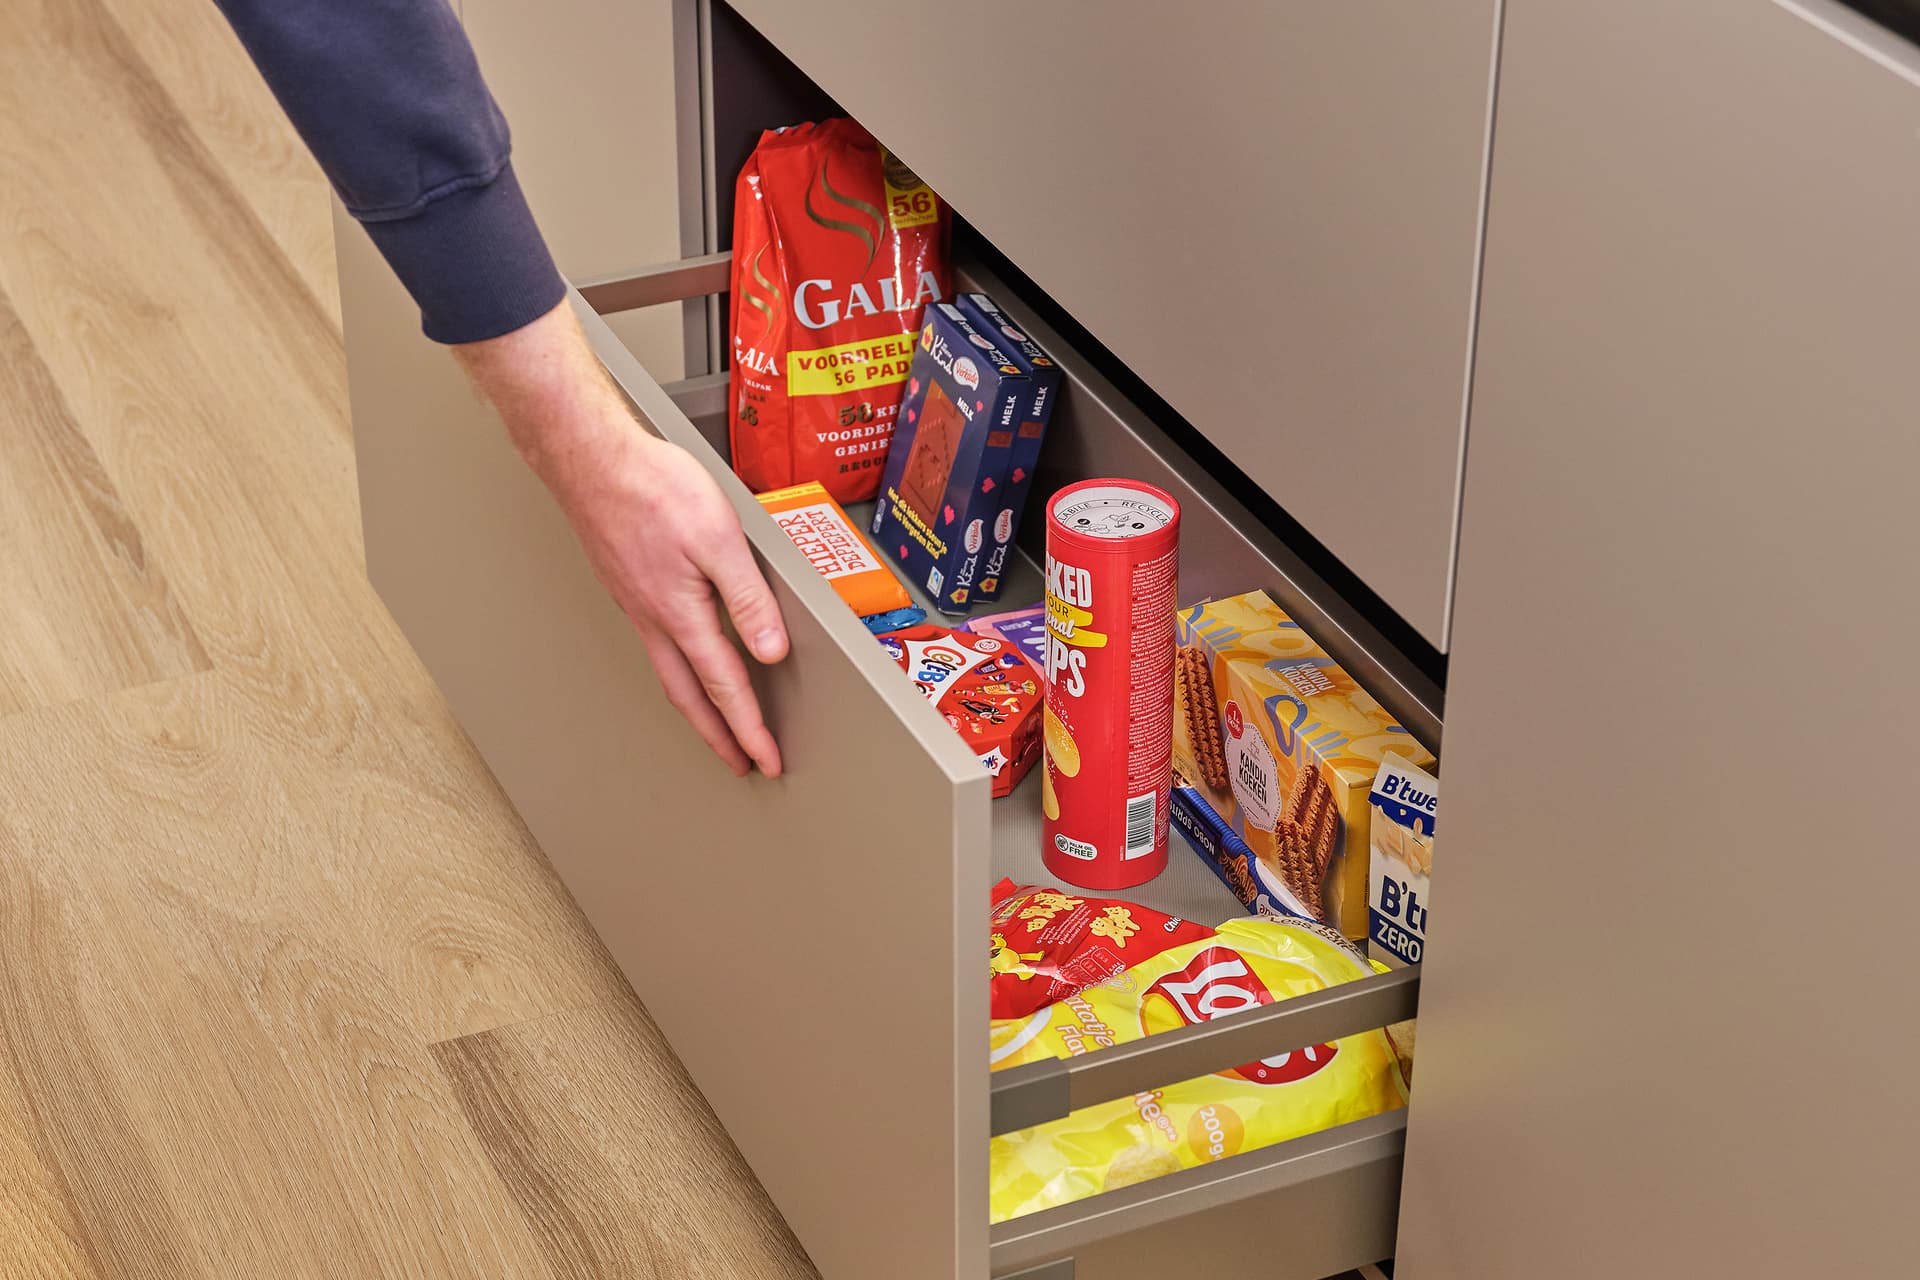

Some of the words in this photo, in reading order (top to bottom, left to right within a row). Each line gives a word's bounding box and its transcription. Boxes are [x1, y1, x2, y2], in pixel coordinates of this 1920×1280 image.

[893, 192, 931, 217] 56
[793, 271, 943, 329] GALA
[835, 370, 855, 386] 56
[866, 360, 912, 380] PAD
[876, 404, 899, 419] KE
[957, 397, 974, 421] MELK
[1001, 395, 1017, 425] MELK
[1032, 386, 1049, 416] MELK
[816, 422, 896, 443] VOORDEL
[834, 438, 893, 457] GENIE
[778, 514, 843, 575] HIEPER
[805, 511, 867, 571] DEPIEPERT
[1046, 594, 1069, 617] OUR
[1046, 607, 1075, 638] inal
[1045, 627, 1086, 698] IPS
[1296, 662, 1336, 691] KANDIJ
[1279, 665, 1320, 697] KOEKEN
[1240, 749, 1267, 788] KANDIJ
[1239, 764, 1267, 805] KOEKEN
[1381, 774, 1438, 812] B'twe
[1069, 847, 1093, 858] FREE
[1377, 919, 1421, 963] ZERO
[1200, 1106, 1225, 1156] 200g
